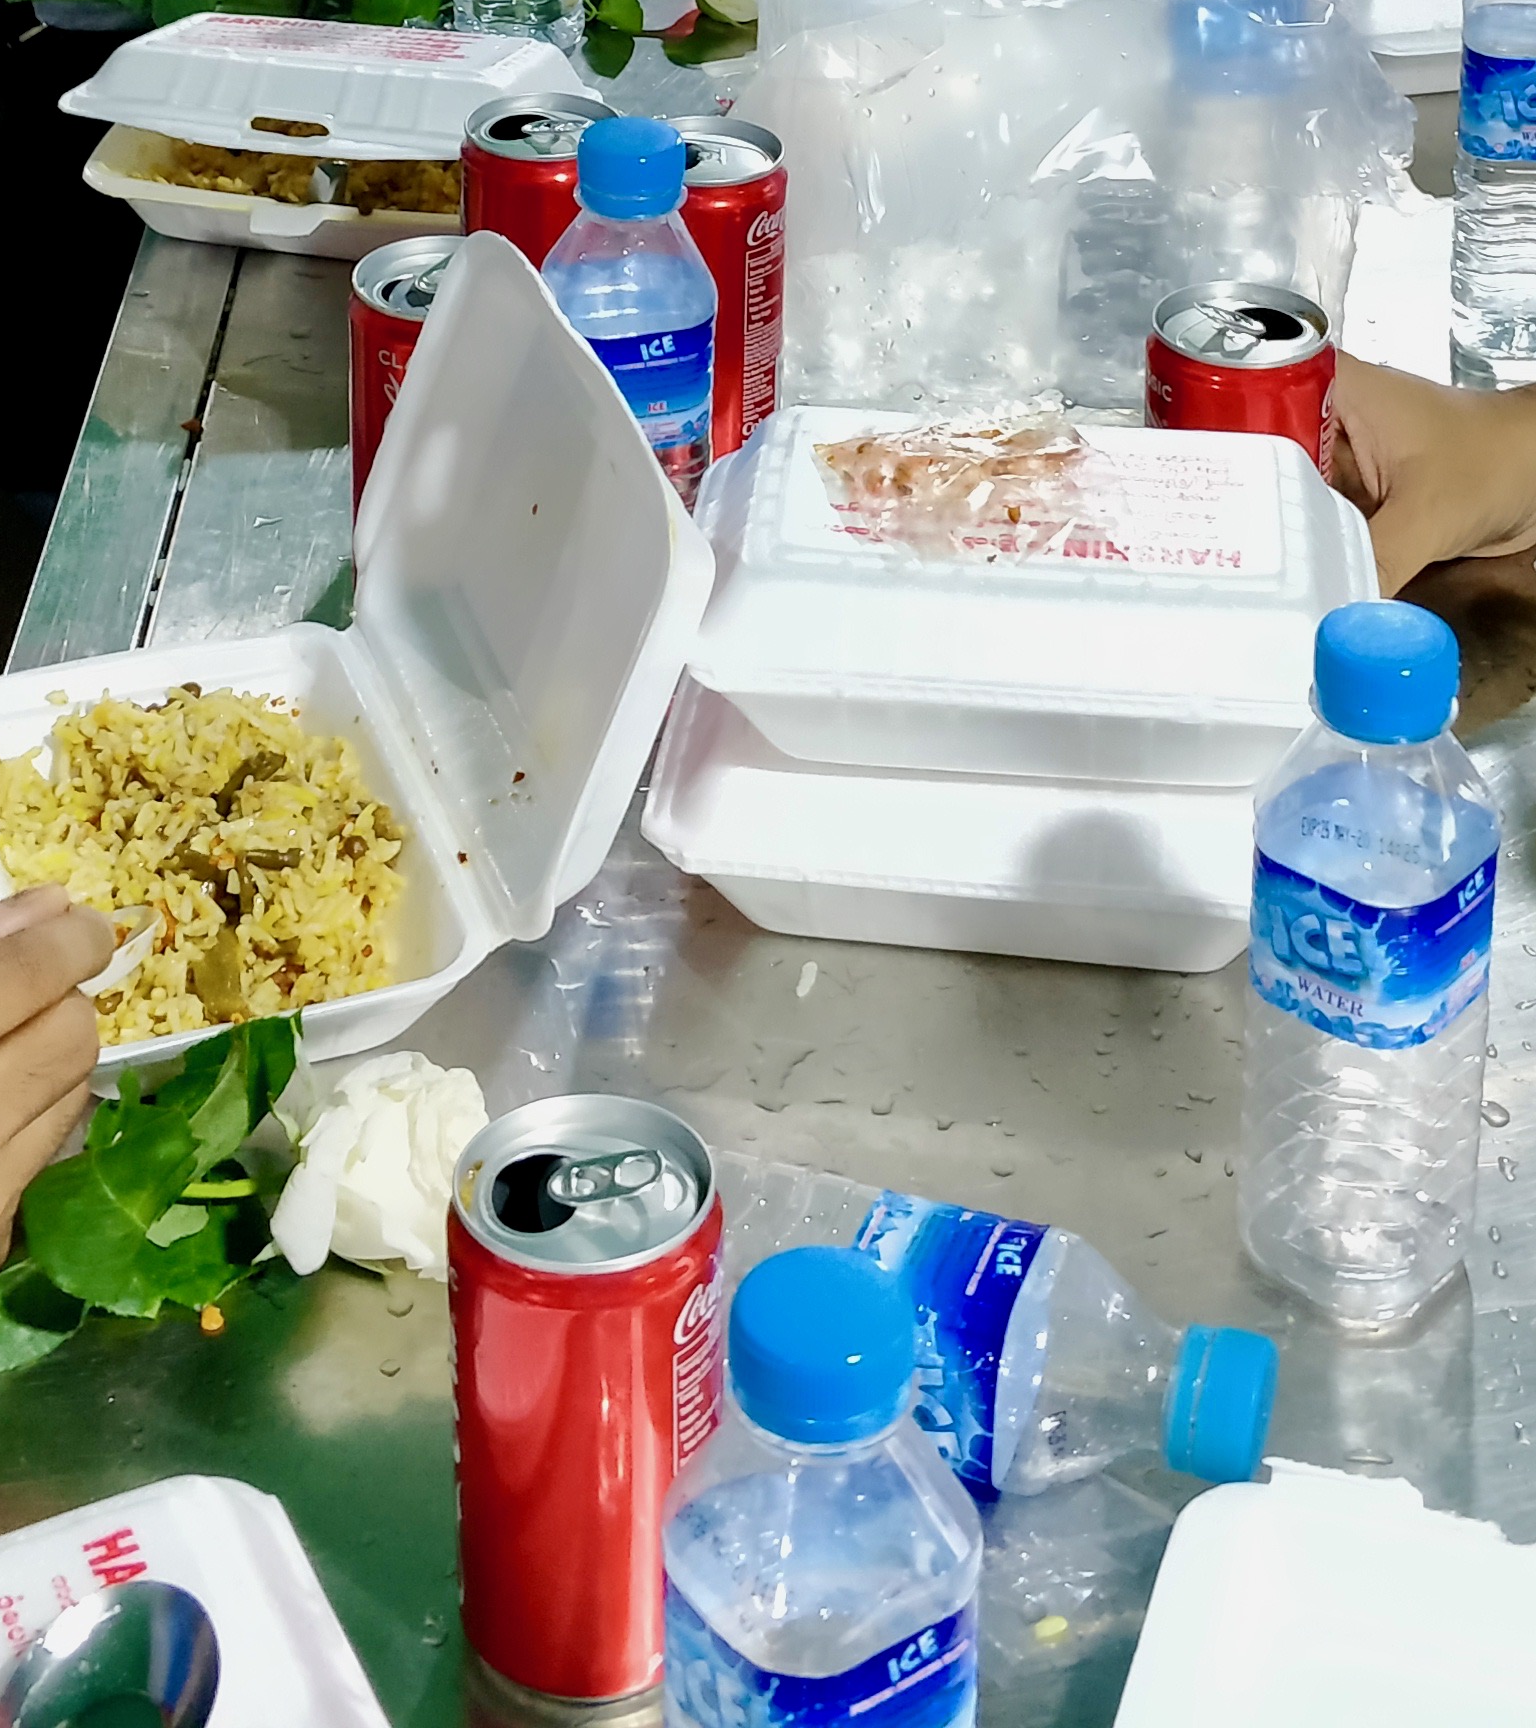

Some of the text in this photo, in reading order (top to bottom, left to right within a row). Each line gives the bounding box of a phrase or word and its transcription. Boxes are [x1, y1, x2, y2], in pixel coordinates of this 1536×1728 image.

[639, 334, 676, 361] ICE
[647, 400, 667, 412] ICE
[1456, 865, 1487, 912] ICE
[1268, 903, 1369, 980] ICE
[1296, 975, 1365, 1018] WATER
[887, 1627, 939, 1683] ICE
